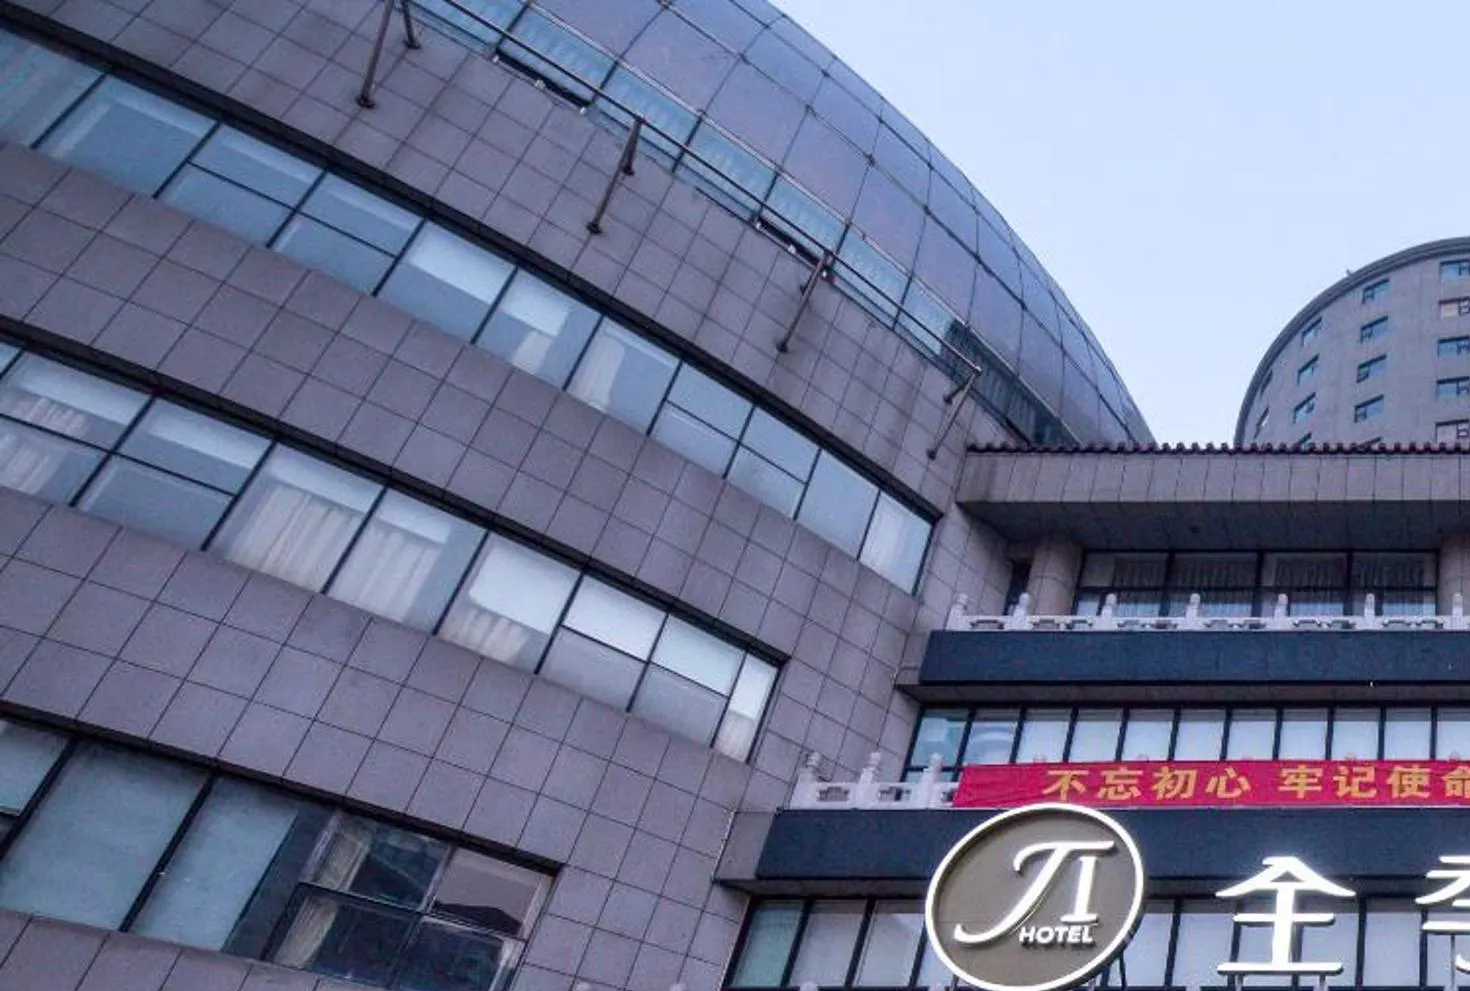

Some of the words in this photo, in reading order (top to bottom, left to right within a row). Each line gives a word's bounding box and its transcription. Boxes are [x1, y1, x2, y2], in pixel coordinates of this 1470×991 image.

[1042, 766, 1252, 801] 不忘初心
[1019, 925, 1095, 945] HOTEL
